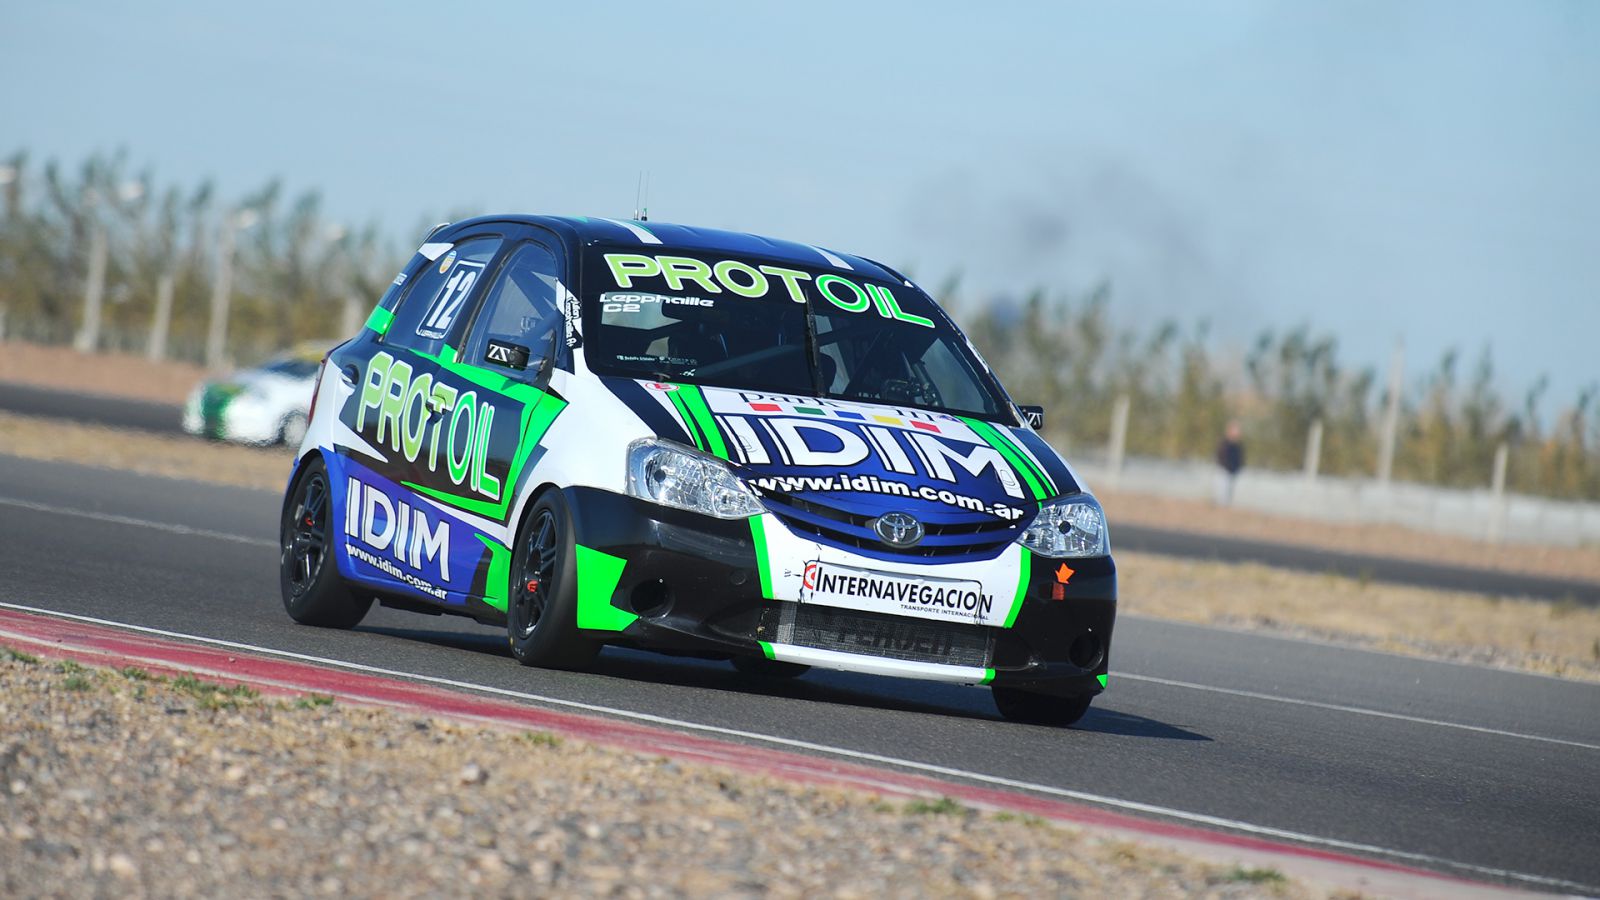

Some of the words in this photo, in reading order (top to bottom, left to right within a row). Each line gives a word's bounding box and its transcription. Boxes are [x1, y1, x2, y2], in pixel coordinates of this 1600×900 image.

[426, 270, 477, 329] 12
[603, 253, 936, 329] PROTOIL
[603, 303, 641, 313] C2
[356, 351, 501, 501] PROTOIL
[714, 415, 1026, 499] IDIM
[344, 477, 451, 582] IDIM
[345, 543, 448, 600] www.idim.com.ar
[815, 566, 993, 614] INTERNAVEGACION
[900, 604, 940, 615] TRANSPORTE
